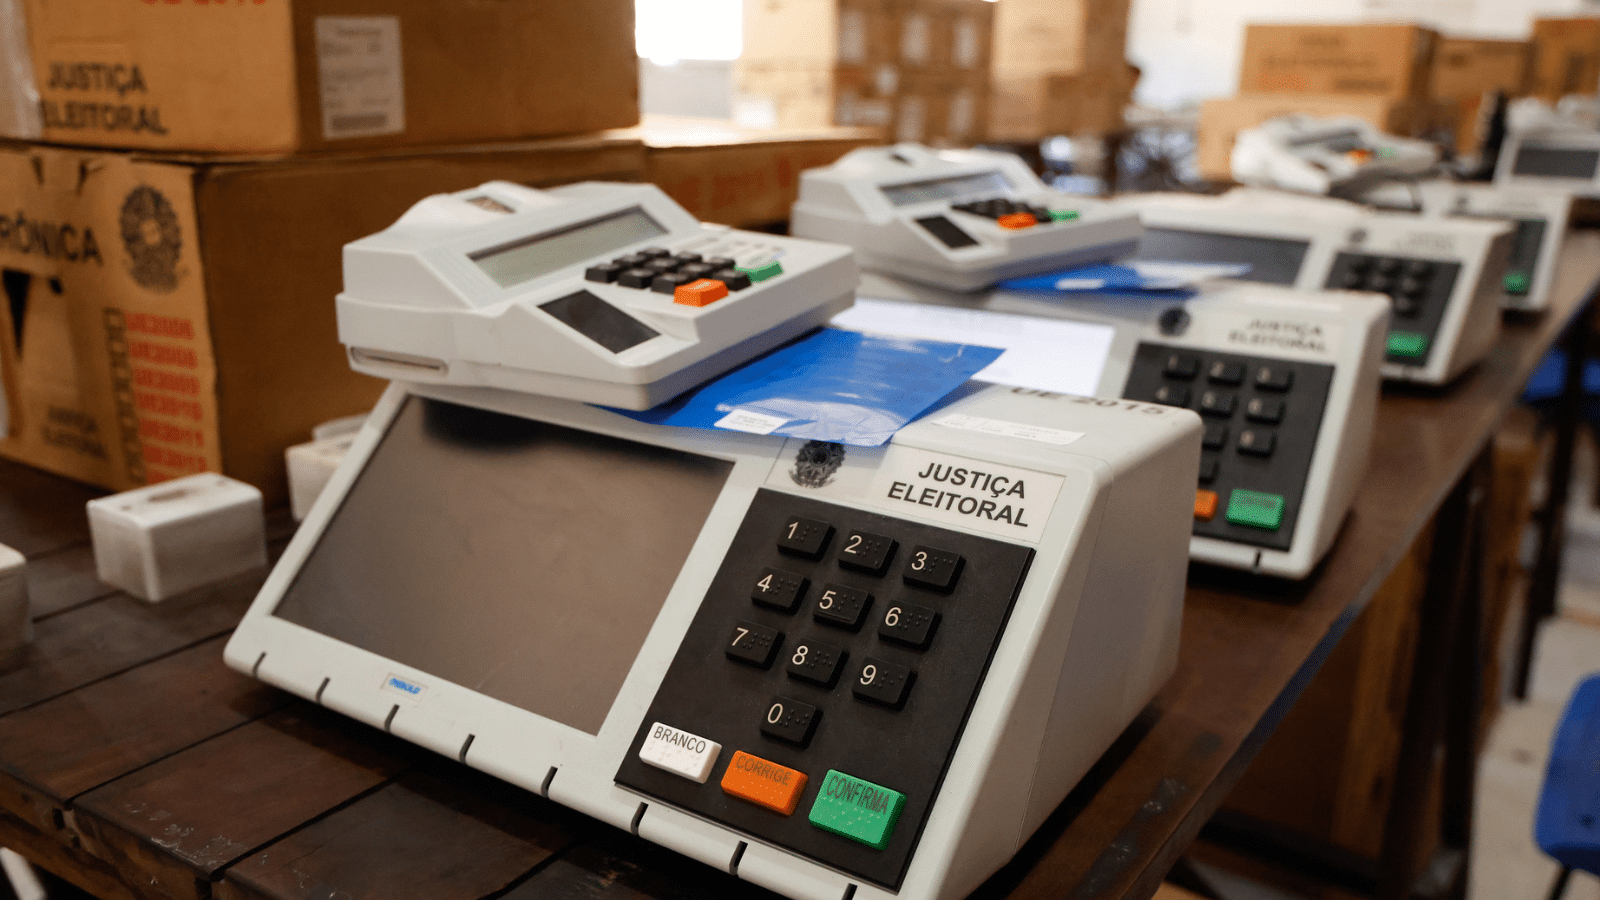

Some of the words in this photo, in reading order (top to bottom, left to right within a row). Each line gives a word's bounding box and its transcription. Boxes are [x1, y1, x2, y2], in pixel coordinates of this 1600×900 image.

[48, 62, 147, 96] JUSTIÇA
[39, 100, 169, 137] ELEITORAL
[918, 462, 1025, 499] JUSTIÇA
[887, 481, 1029, 528] ELEITORAL
[787, 521, 799, 540] 1
[844, 534, 863, 554] 2
[911, 551, 928, 571] 3
[757, 574, 773, 593] 4
[819, 590, 837, 610] 5
[884, 606, 902, 627] 6
[731, 627, 749, 646] 7
[791, 645, 809, 665] 8
[859, 664, 877, 685] 9
[767, 703, 784, 724] 0
[653, 726, 707, 754] BRANCO
[735, 755, 793, 786] CORRIGE
[826, 775, 890, 815] CONFIRMA
